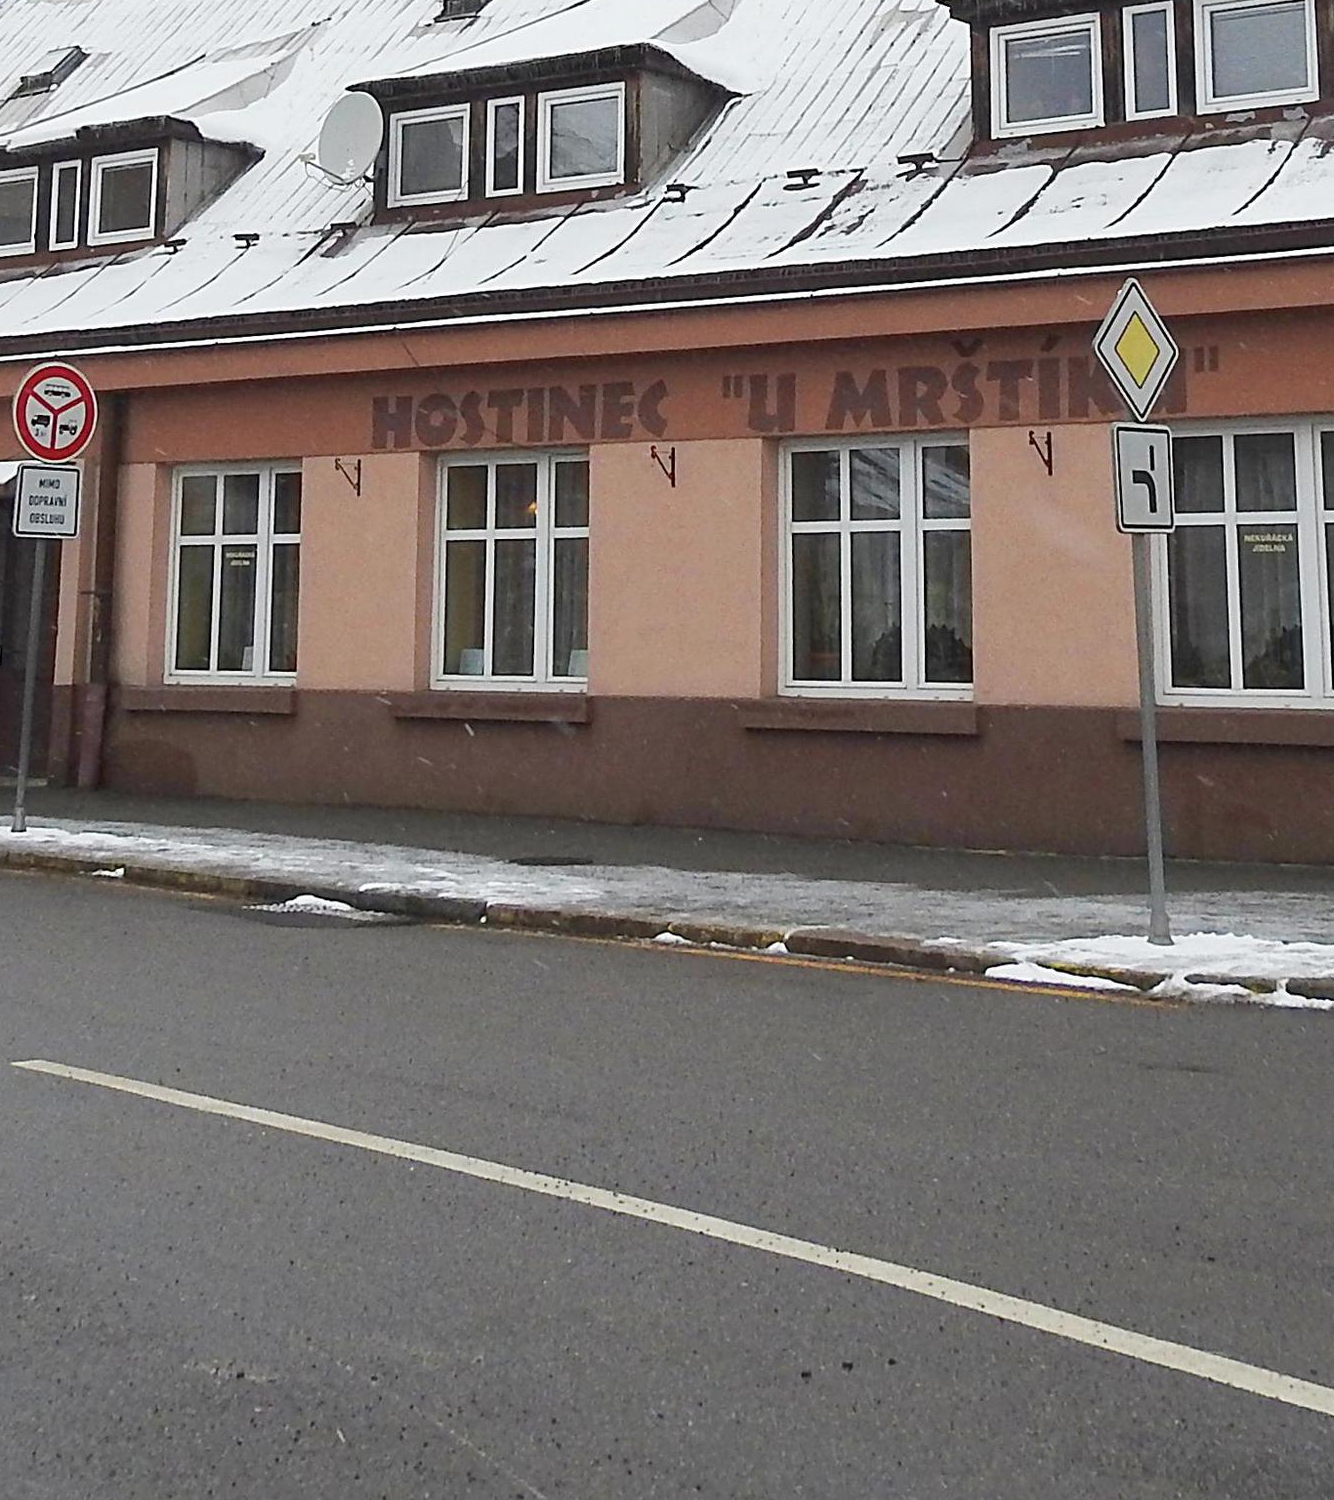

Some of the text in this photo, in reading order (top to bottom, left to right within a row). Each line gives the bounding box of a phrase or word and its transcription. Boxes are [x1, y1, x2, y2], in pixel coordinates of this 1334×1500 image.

[370, 378, 668, 451] HOSTINEC
[38, 478, 61, 490] MIMO
[28, 493, 67, 507] DOPRAVNÍ
[29, 512, 65, 525] OBSLUHU
